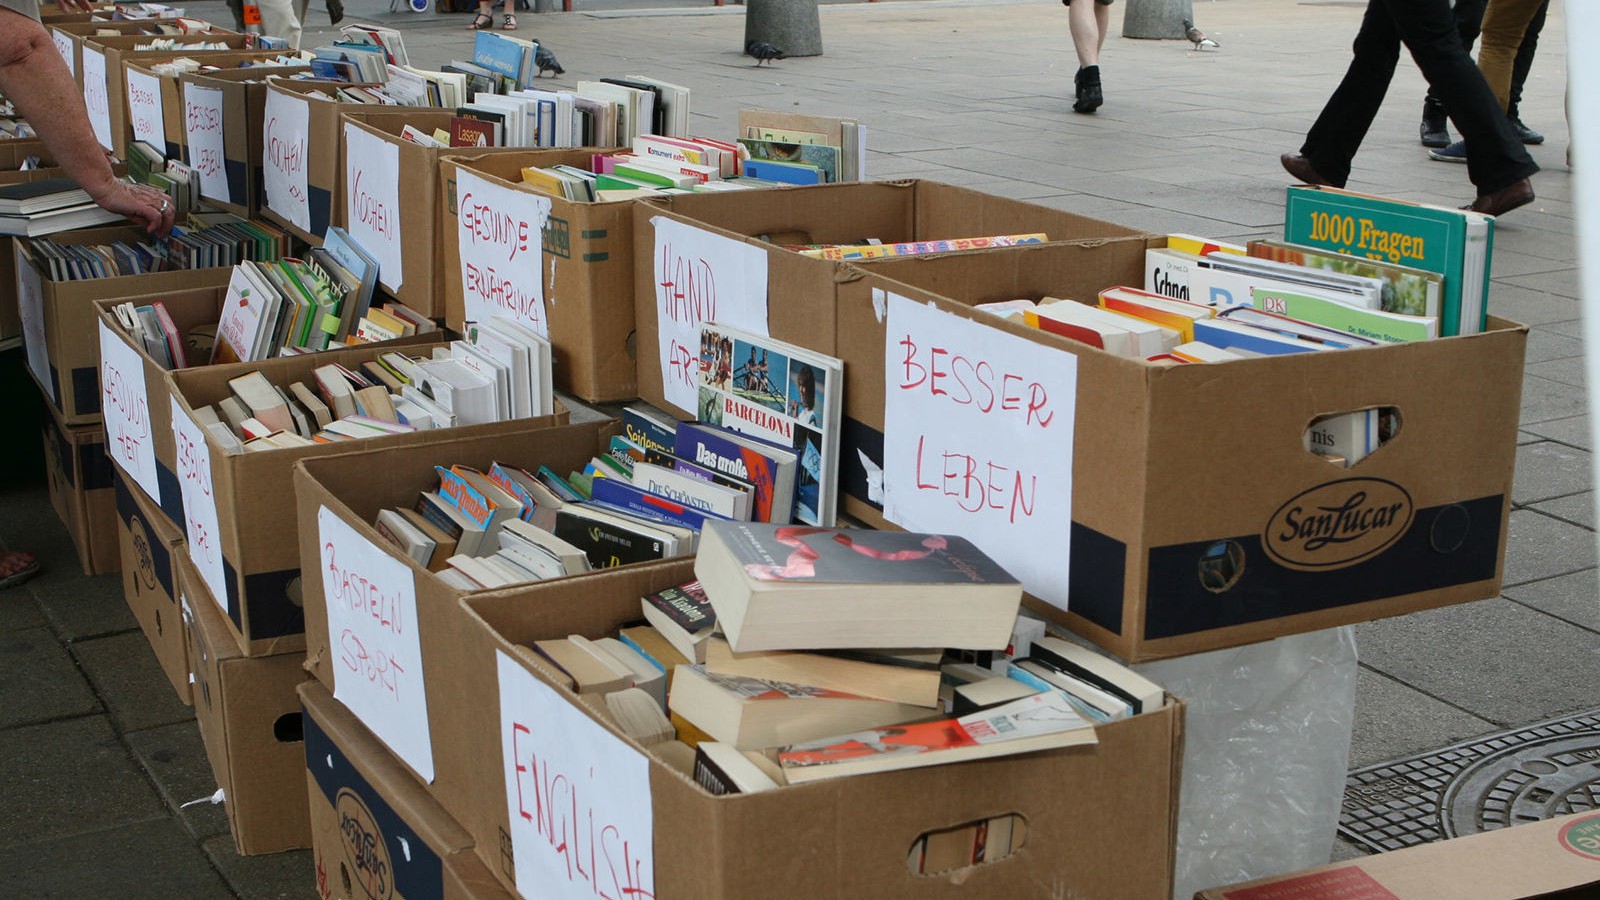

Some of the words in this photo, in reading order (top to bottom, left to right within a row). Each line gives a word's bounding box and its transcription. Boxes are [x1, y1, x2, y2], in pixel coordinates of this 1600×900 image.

[187, 101, 222, 135] BESSER
[353, 166, 393, 241] KOCHEN
[460, 192, 529, 262] GESUNDE
[1308, 211, 1355, 246] 1000
[1357, 218, 1425, 264] Fragen
[661, 242, 716, 328] HAND
[1263, 297, 1286, 313] DK
[900, 334, 1054, 428] BESSER
[725, 397, 791, 440] BARCELONA
[1310, 429, 1336, 447] nis
[695, 441, 717, 469] Das
[916, 435, 1037, 524] LEBEN
[1279, 490, 1403, 552] SanLucar
[325, 541, 403, 635] BASTELN
[341, 629, 405, 701] SPORT
